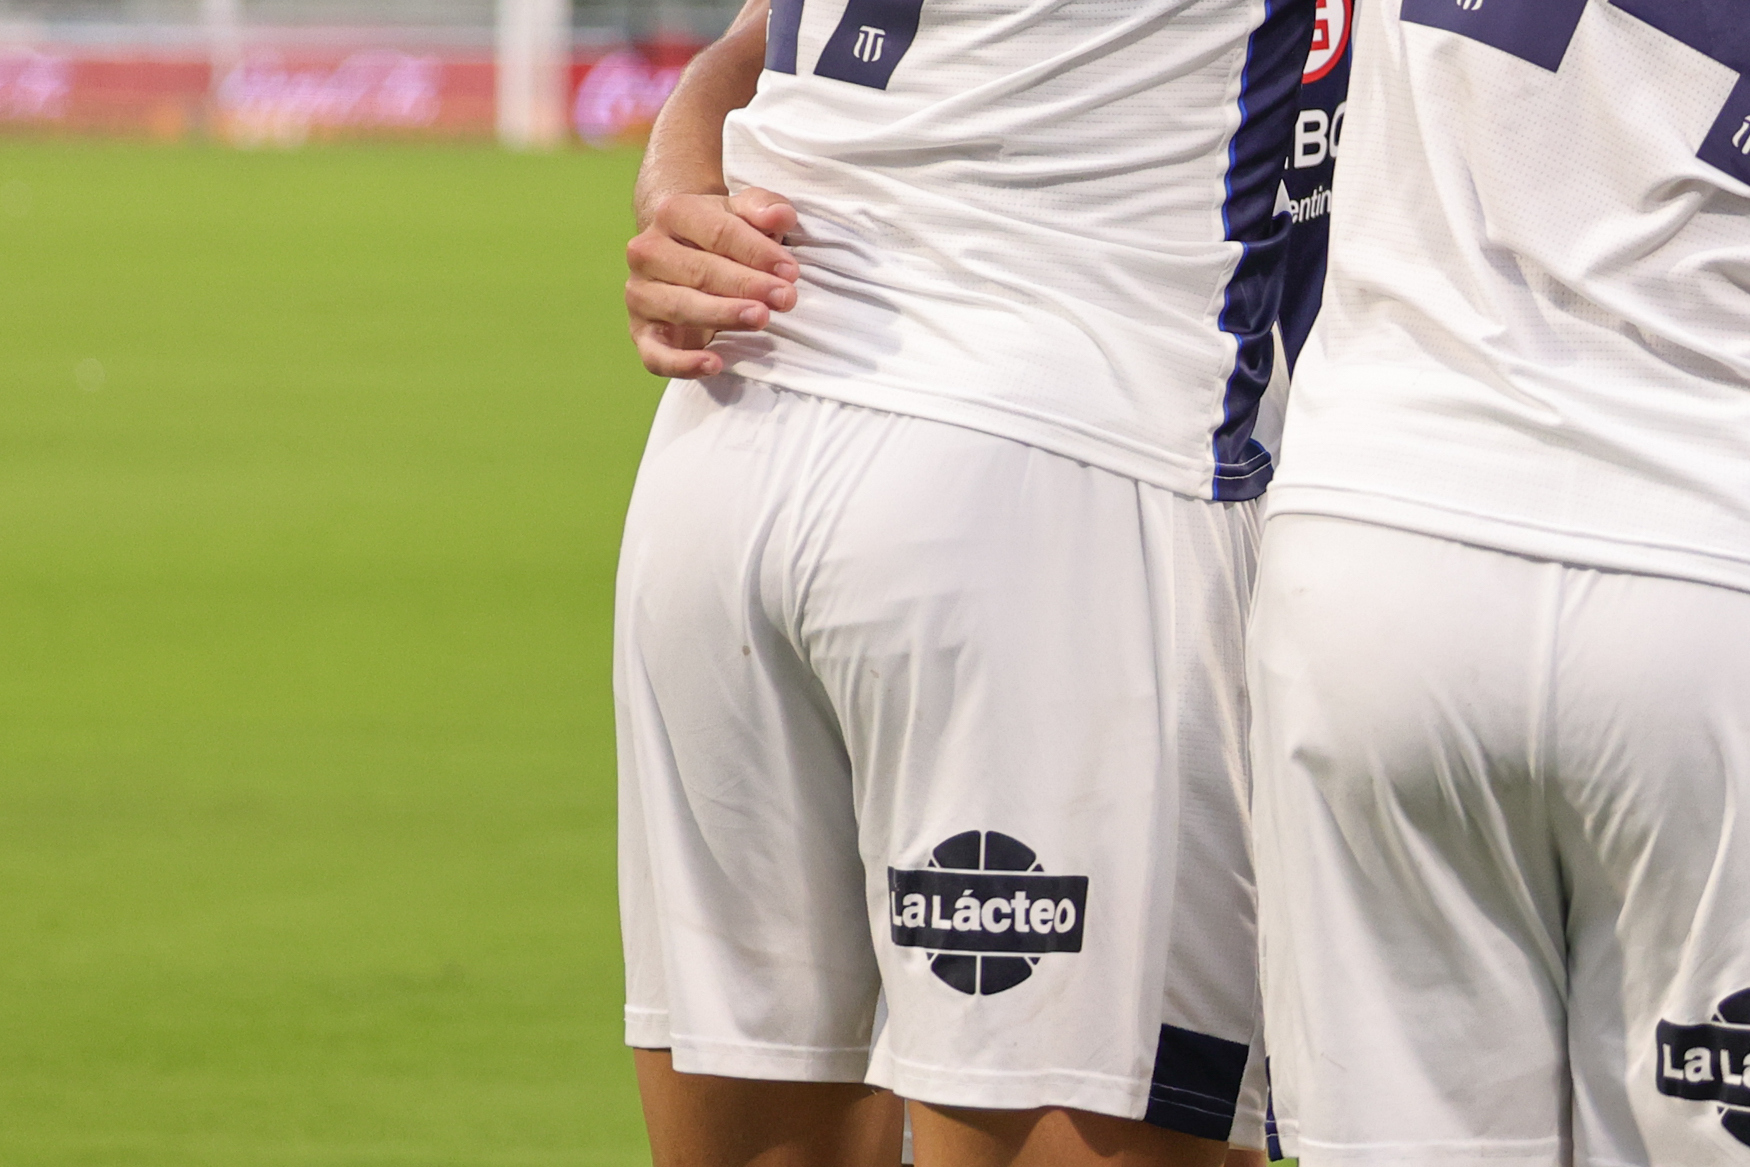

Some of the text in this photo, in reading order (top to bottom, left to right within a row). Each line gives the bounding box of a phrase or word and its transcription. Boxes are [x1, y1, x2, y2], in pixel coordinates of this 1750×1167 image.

[1289, 185, 1332, 224] entin
[891, 889, 1077, 934] La Lácteo
[1662, 1043, 1715, 1083] La
